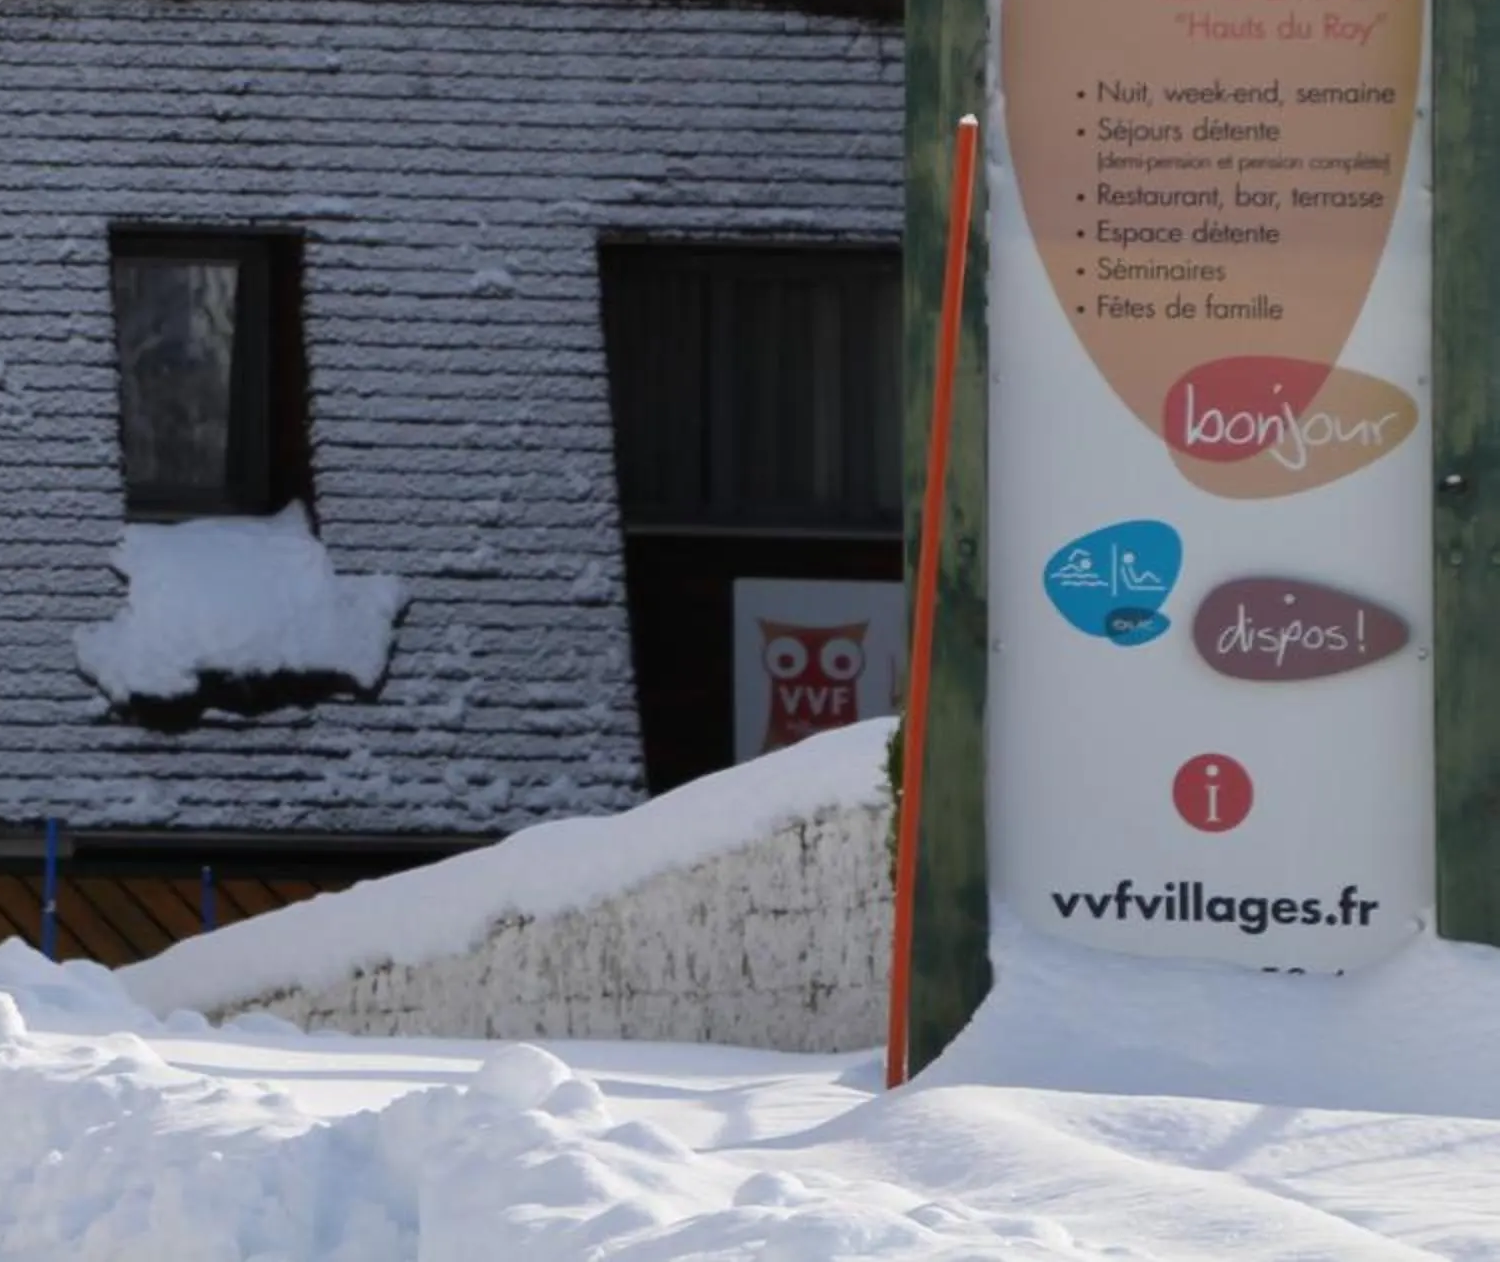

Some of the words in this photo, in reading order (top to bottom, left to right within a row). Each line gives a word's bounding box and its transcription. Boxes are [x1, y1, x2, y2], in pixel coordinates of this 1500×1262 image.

[1277, 12, 1312, 40] du
[1097, 80, 1153, 106] Nuit,
[1164, 79, 1284, 106] week-end,
[1296, 81, 1396, 105] semaine
[1097, 116, 1182, 146] Séjours
[1192, 116, 1280, 141] détente
[1216, 154, 1233, 170] et
[1238, 152, 1303, 174] pension
[1097, 182, 1224, 210] Restaurant,
[1235, 182, 1281, 210] bar,
[1292, 185, 1384, 208] terrasse
[1097, 220, 1182, 250] Espace
[1192, 218, 1280, 244] détente
[1097, 256, 1226, 281] Séminaires
[1097, 294, 1156, 319] Fêtes
[1166, 294, 1196, 319] de
[1205, 293, 1284, 320] famille
[1185, 383, 1396, 470] bonjour
[779, 686, 849, 716] VVF
[1051, 880, 1379, 933] vvfvillages.fr
